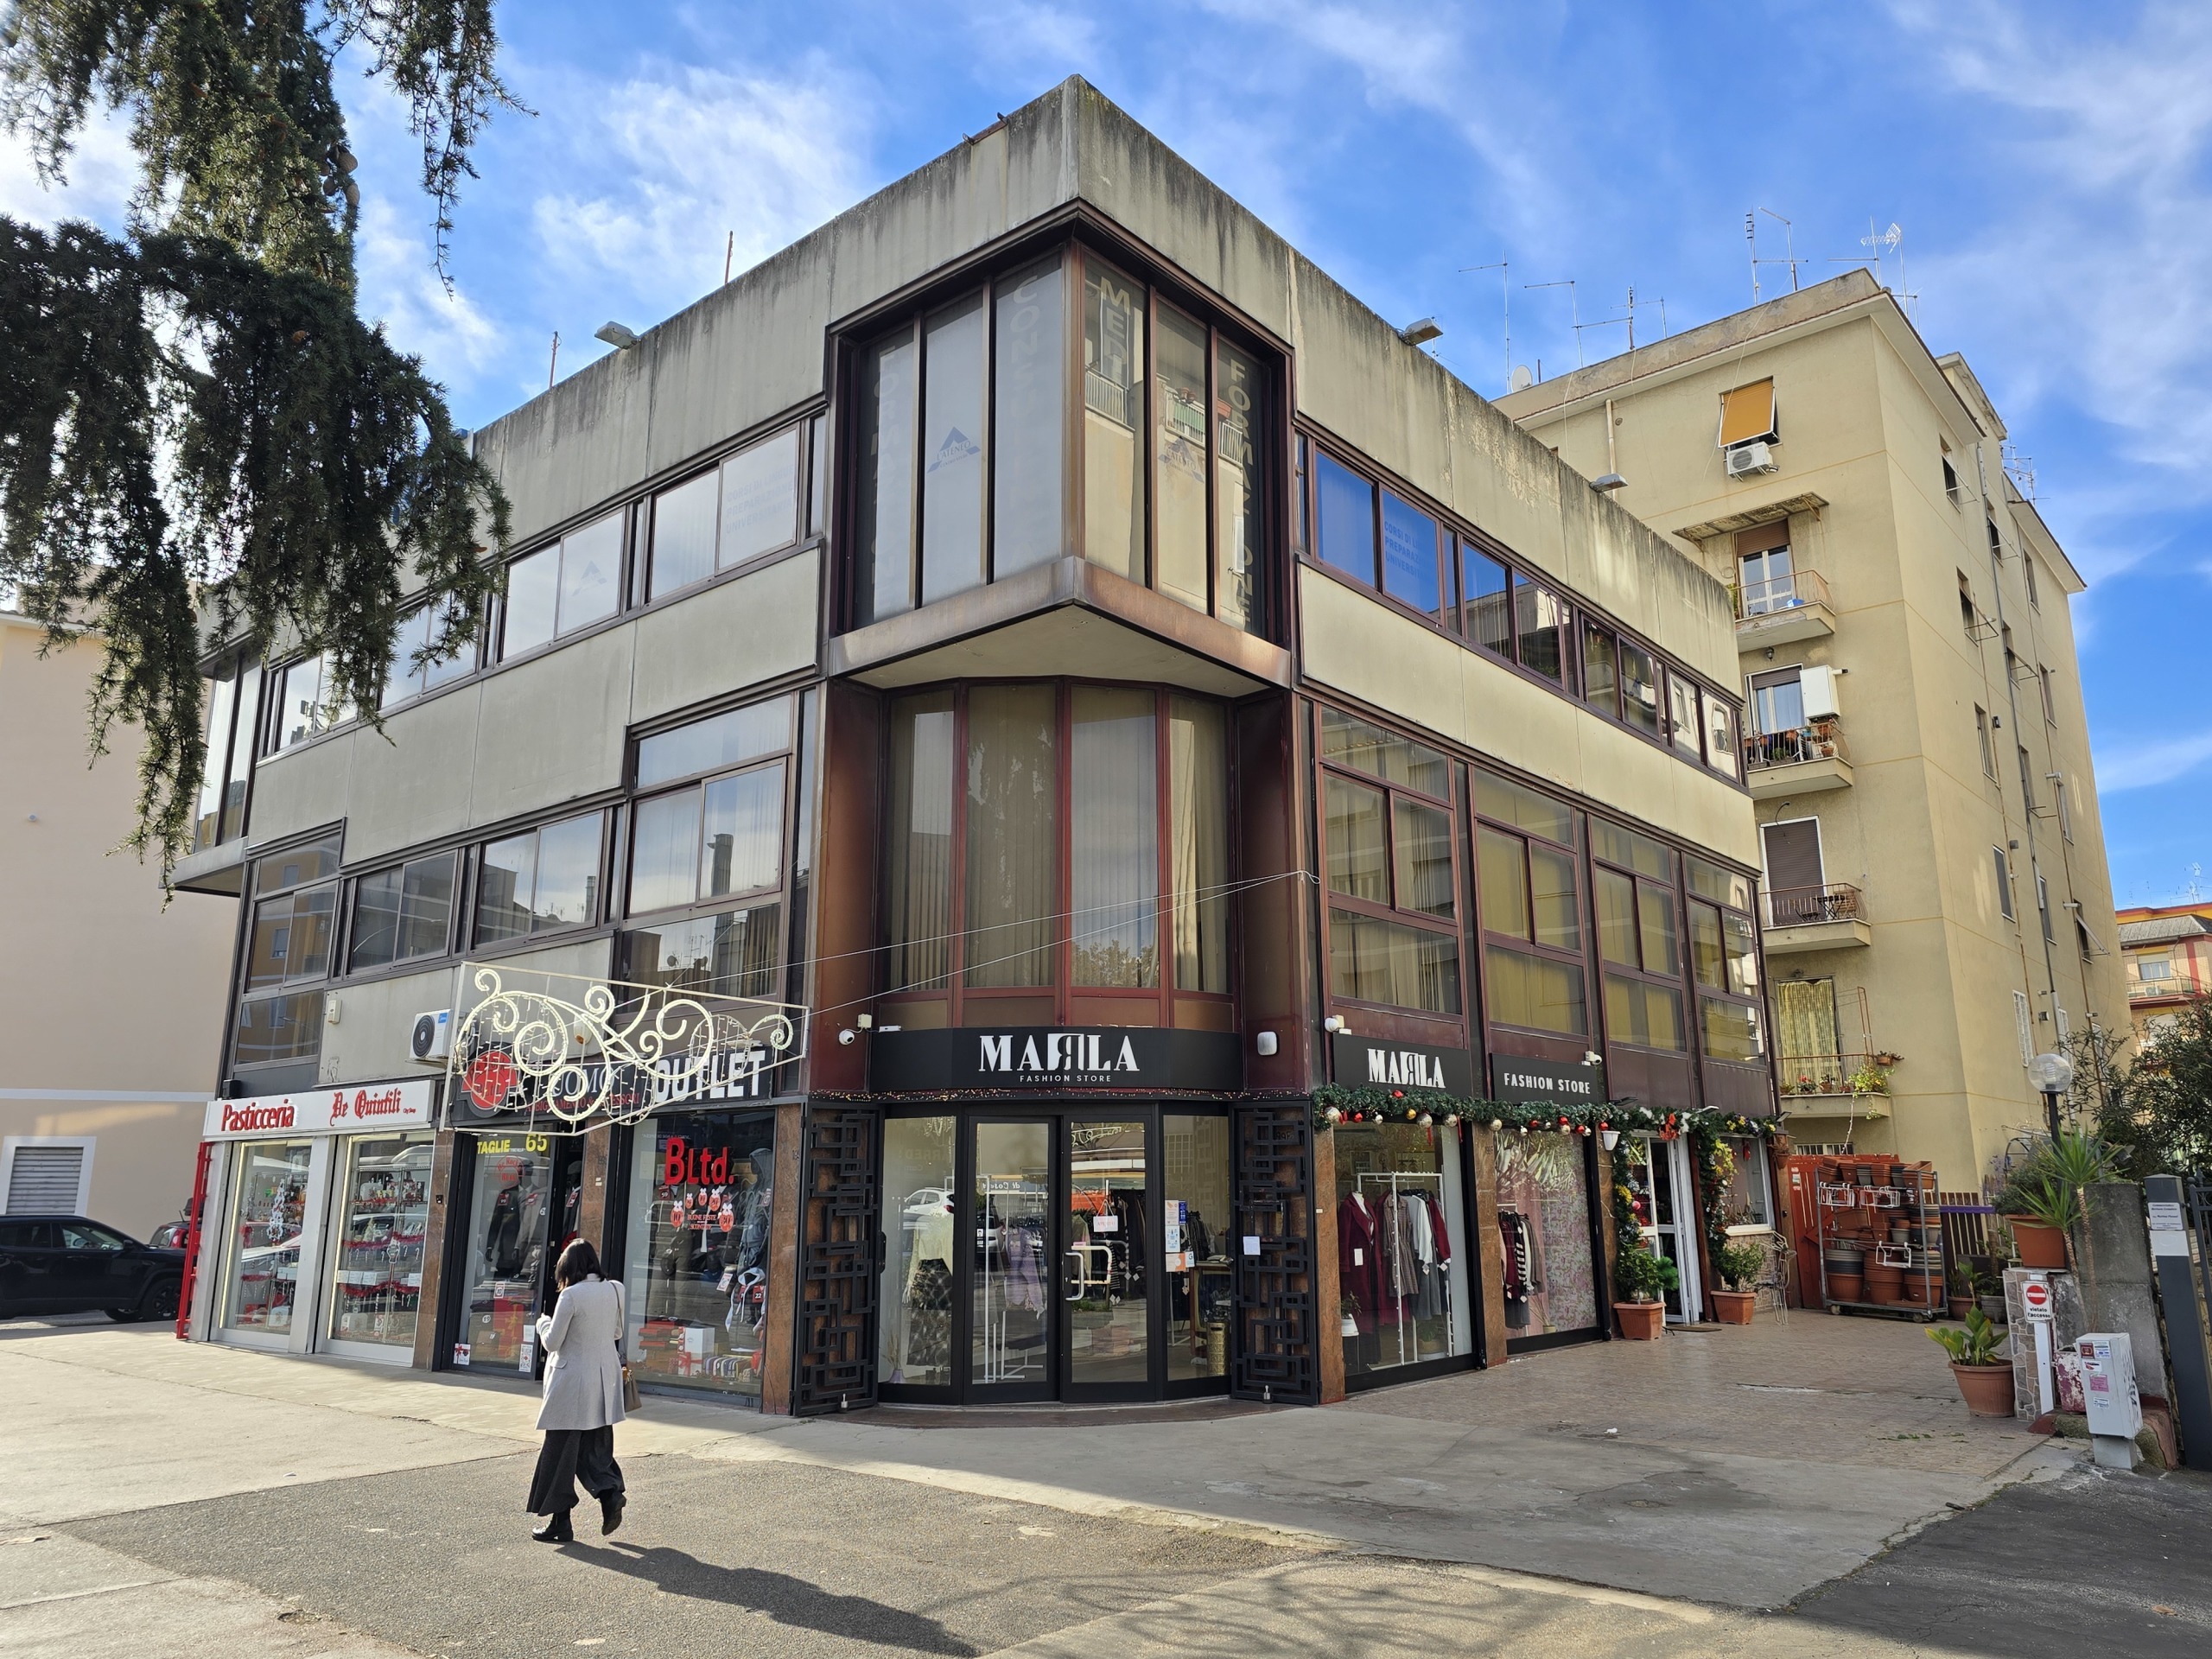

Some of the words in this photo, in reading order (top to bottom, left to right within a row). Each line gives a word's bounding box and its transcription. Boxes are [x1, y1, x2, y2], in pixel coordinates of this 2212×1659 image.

[1384, 521, 1404, 540] CORSI
[656, 1050, 766, 1103] OUTLET
[1503, 1072, 1554, 1090] FASHION
[1558, 1079, 1591, 1095] STORE
[221, 1098, 295, 1131] Pasticceria
[329, 1090, 349, 1127] De
[477, 1139, 511, 1154] TAGLIE
[525, 1133, 548, 1152] 65
